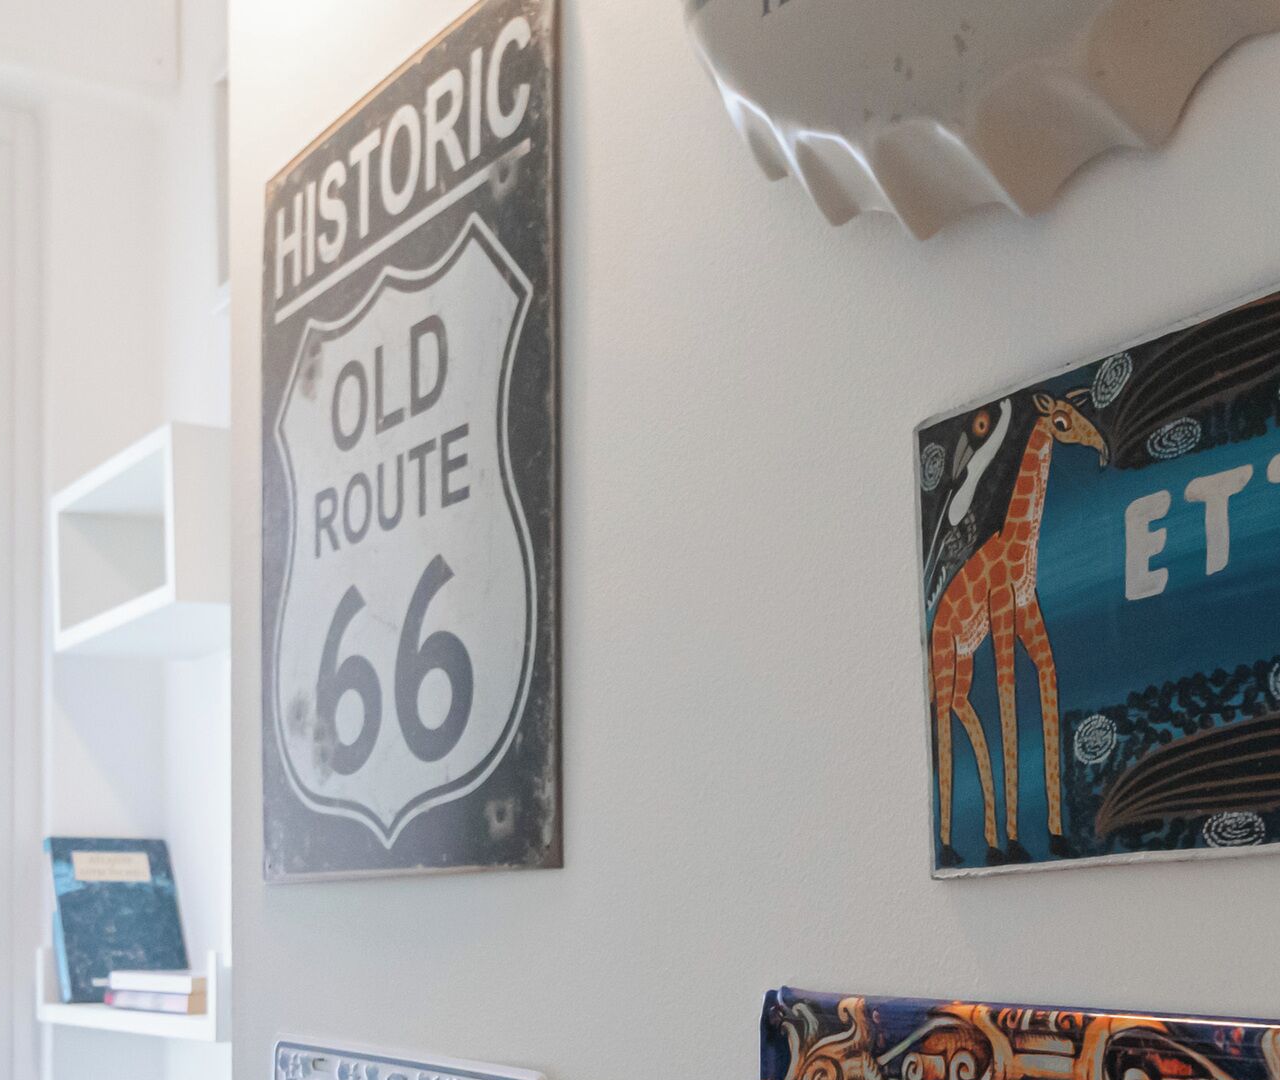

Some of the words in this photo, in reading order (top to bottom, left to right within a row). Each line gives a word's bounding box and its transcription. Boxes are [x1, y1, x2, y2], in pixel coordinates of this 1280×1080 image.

[275, 16, 532, 300] HISTORIC
[331, 313, 449, 448] OLD
[314, 422, 470, 559] ROUTE
[316, 553, 474, 776] 66
